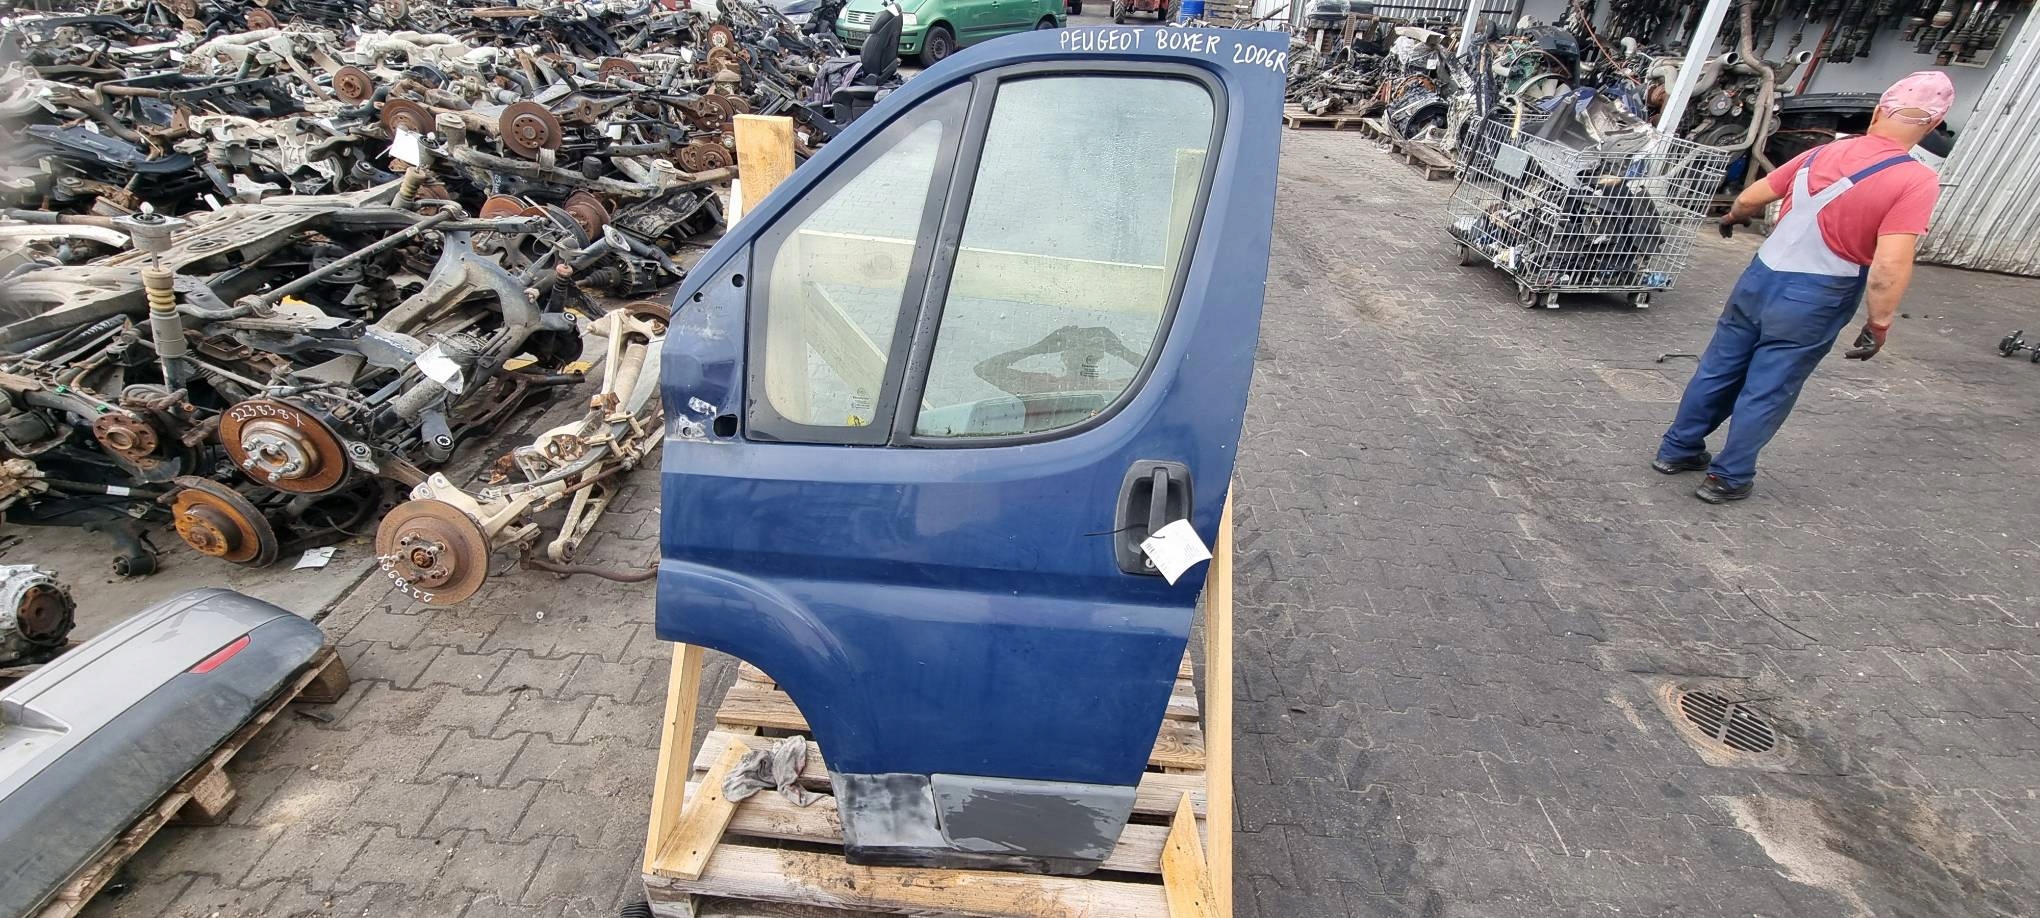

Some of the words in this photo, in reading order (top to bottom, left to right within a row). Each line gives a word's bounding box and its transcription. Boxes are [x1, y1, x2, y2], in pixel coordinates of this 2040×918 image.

[1059, 28, 1145, 51] PEUGEOT
[1155, 28, 1221, 54] BOXER
[1232, 43, 1287, 74] 2006R
